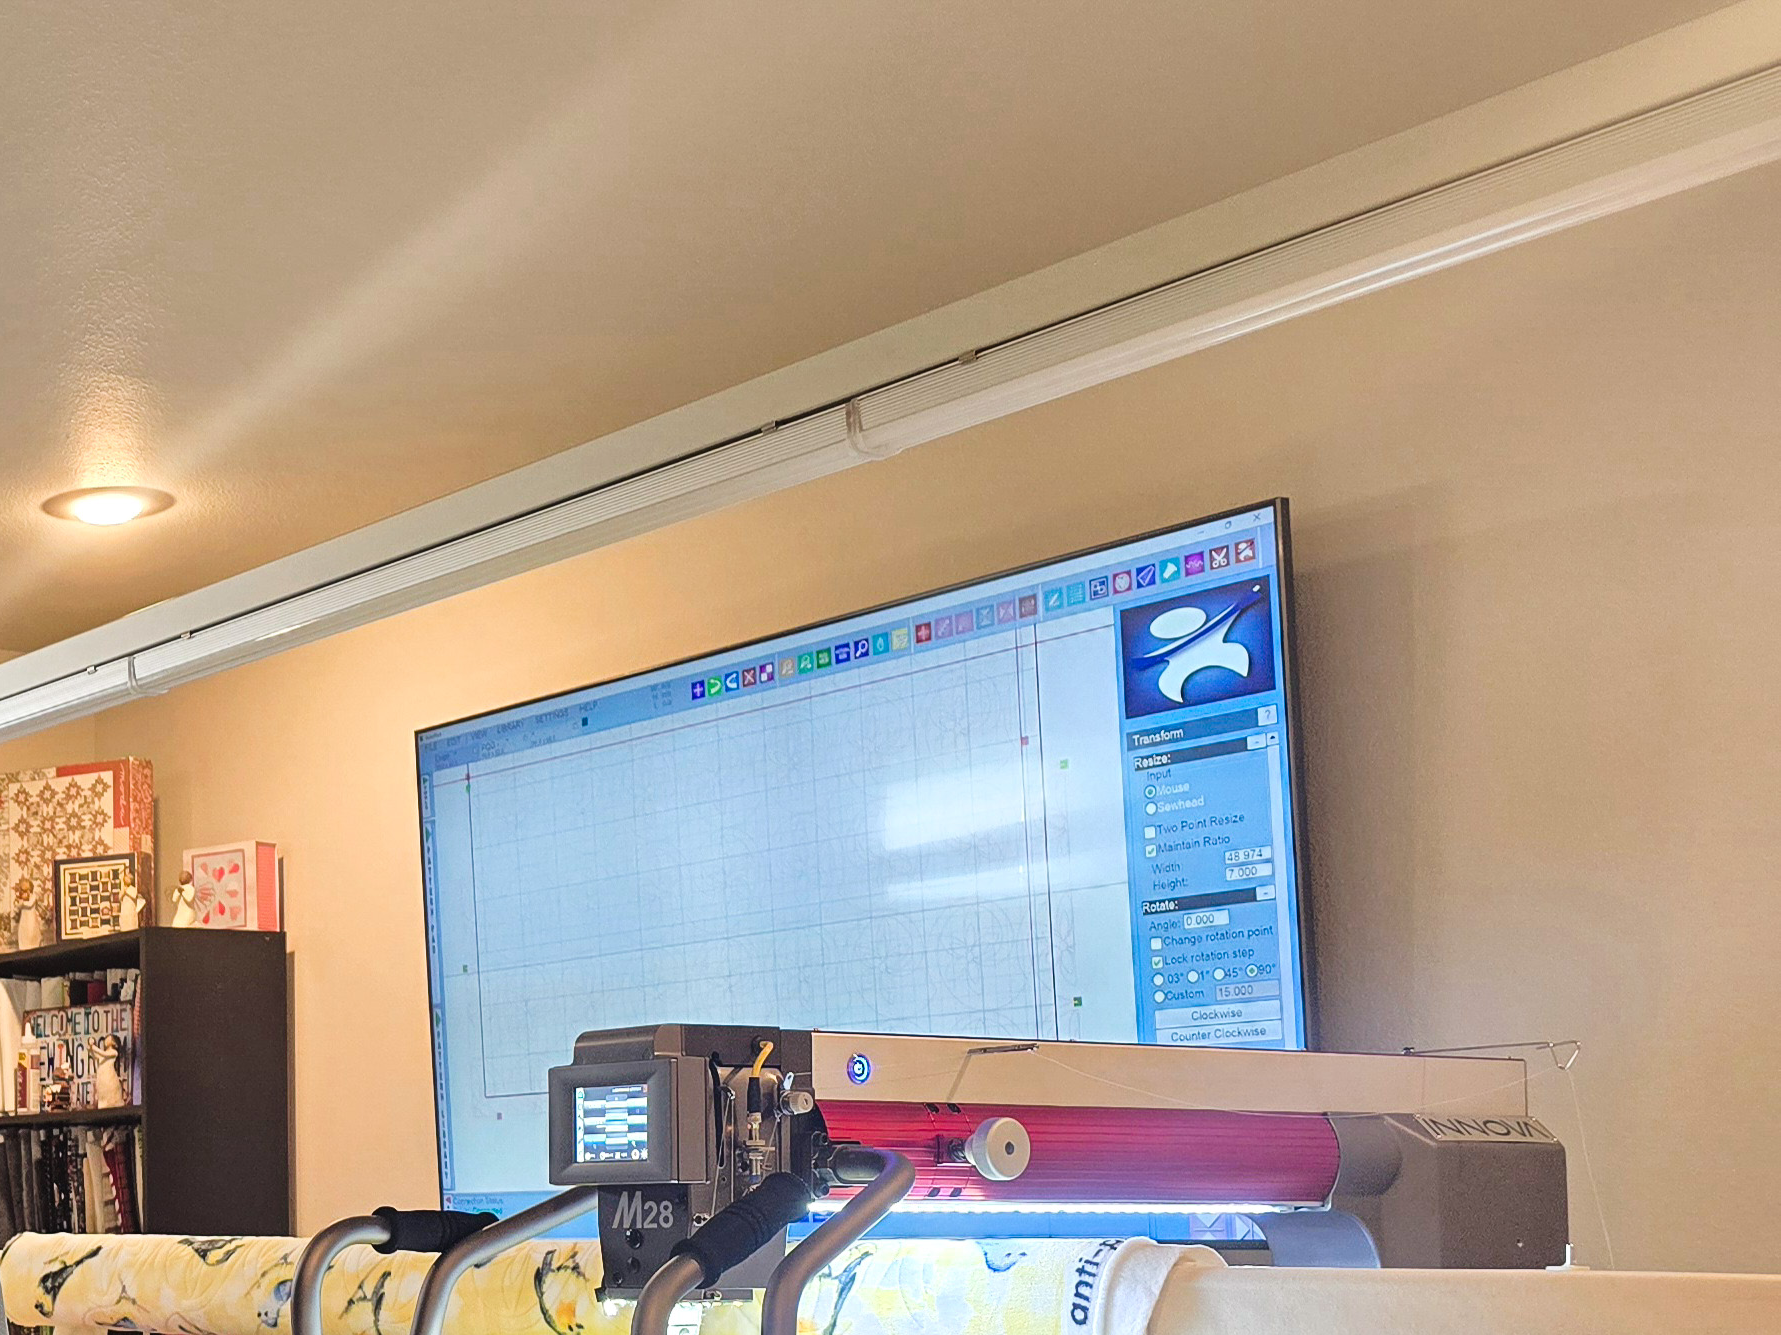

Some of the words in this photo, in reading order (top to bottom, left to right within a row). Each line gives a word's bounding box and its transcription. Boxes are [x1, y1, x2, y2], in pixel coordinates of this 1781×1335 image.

[1132, 728, 1184, 746] Transform
[1134, 753, 1171, 769] Resize:
[1146, 768, 1171, 782] Input
[1156, 783, 1190, 795] Mouse
[1157, 795, 1205, 813] Sewhead
[1180, 818, 1207, 831] Point
[1209, 813, 1245, 827] Resize
[1158, 838, 1200, 853] Maintain
[1202, 835, 1231, 846] Ratio
[1153, 877, 1189, 892] Height:
[1228, 866, 1258, 879] 7.000
[1142, 900, 1179, 914] Rotate:
[1149, 920, 1181, 933] Angle:
[1186, 913, 1215, 926] 0.000
[1164, 934, 1203, 947] Change
[1205, 928, 1245, 942] rotation
[1247, 925, 1274, 939] point
[1164, 955, 1188, 966] Lock
[1190, 949, 1230, 962] rotation
[1232, 947, 1255, 961] step
[1165, 988, 1205, 1001] Custom
[1219, 984, 1254, 997] 15.000
[84, 1009, 99, 1036] TO
[104, 1008, 128, 1033] THE
[1191, 1008, 1243, 1021] Clockwise
[1171, 1033, 1212, 1042] Counter
[1214, 1027, 1267, 1039] Clockwise
[1421, 1117, 1550, 1140] INNOVA
[612, 1190, 674, 1229] M28
